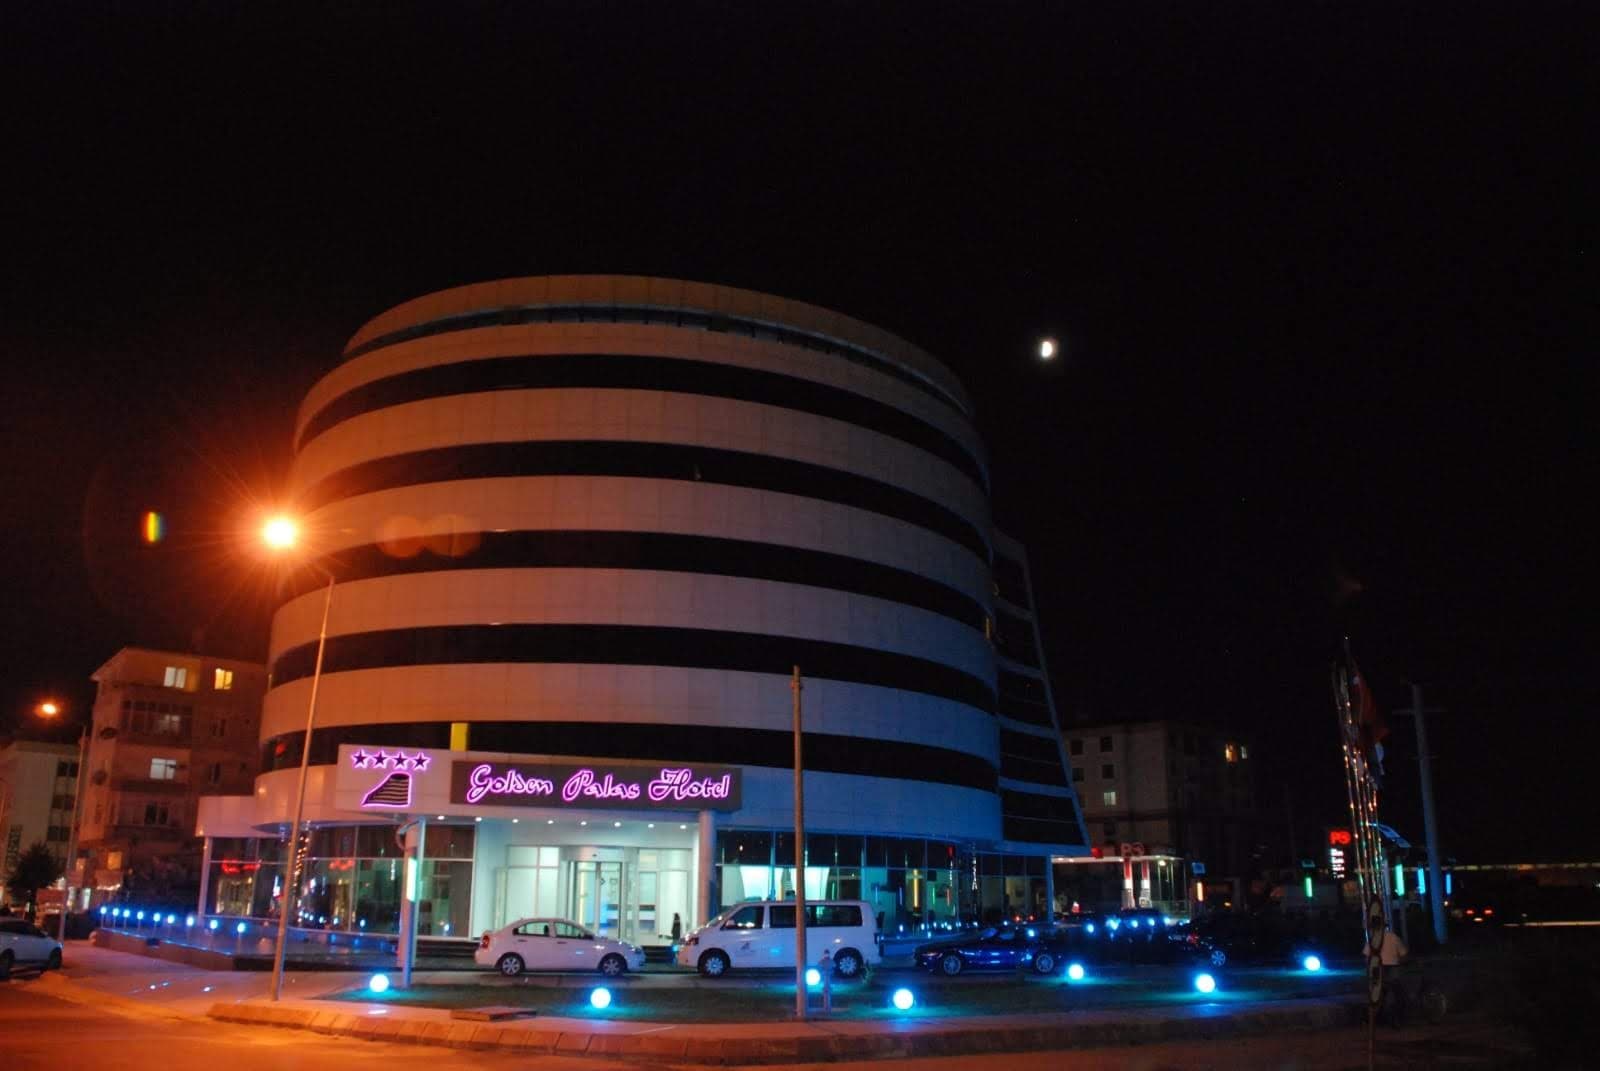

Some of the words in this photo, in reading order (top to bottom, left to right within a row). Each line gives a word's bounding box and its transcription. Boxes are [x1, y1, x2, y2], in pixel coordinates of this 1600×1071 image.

[467, 764, 553, 802] Golden
[562, 769, 640, 801] Palas
[648, 768, 730, 801] Hotel
